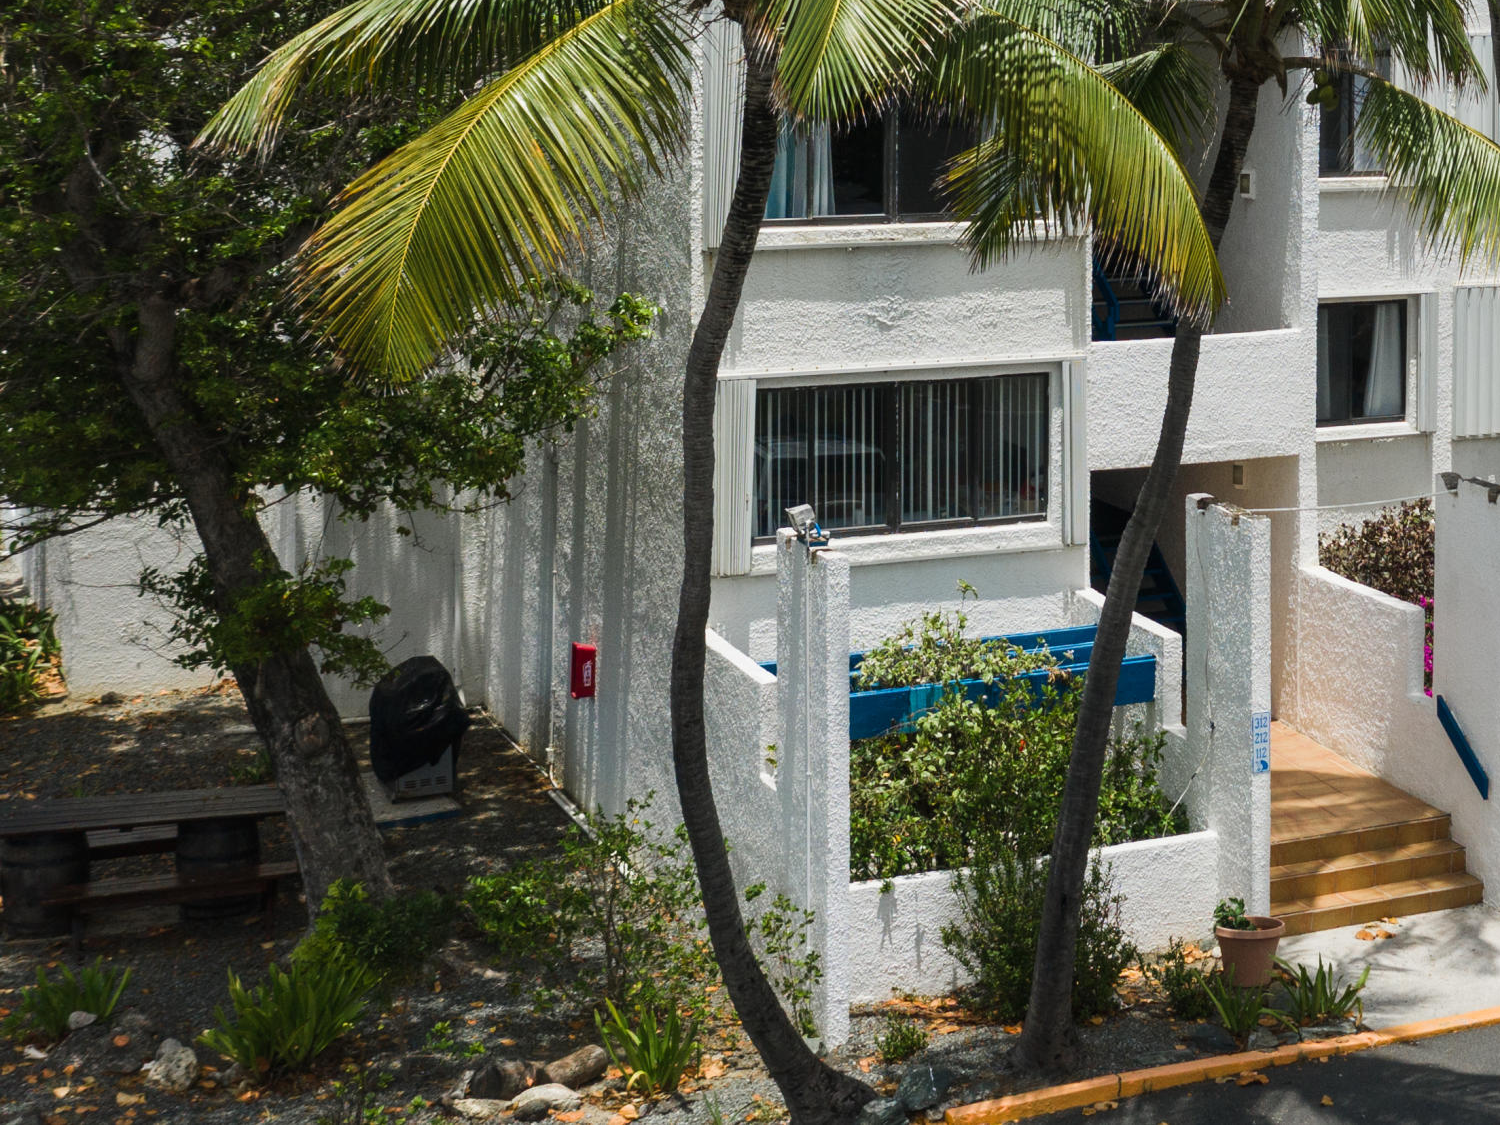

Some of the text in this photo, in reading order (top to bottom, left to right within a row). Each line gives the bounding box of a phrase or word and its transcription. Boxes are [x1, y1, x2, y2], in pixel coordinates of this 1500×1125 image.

[1254, 716, 1268, 729] 312
[1254, 731, 1268, 744] 212
[1255, 747, 1267, 759] 112
